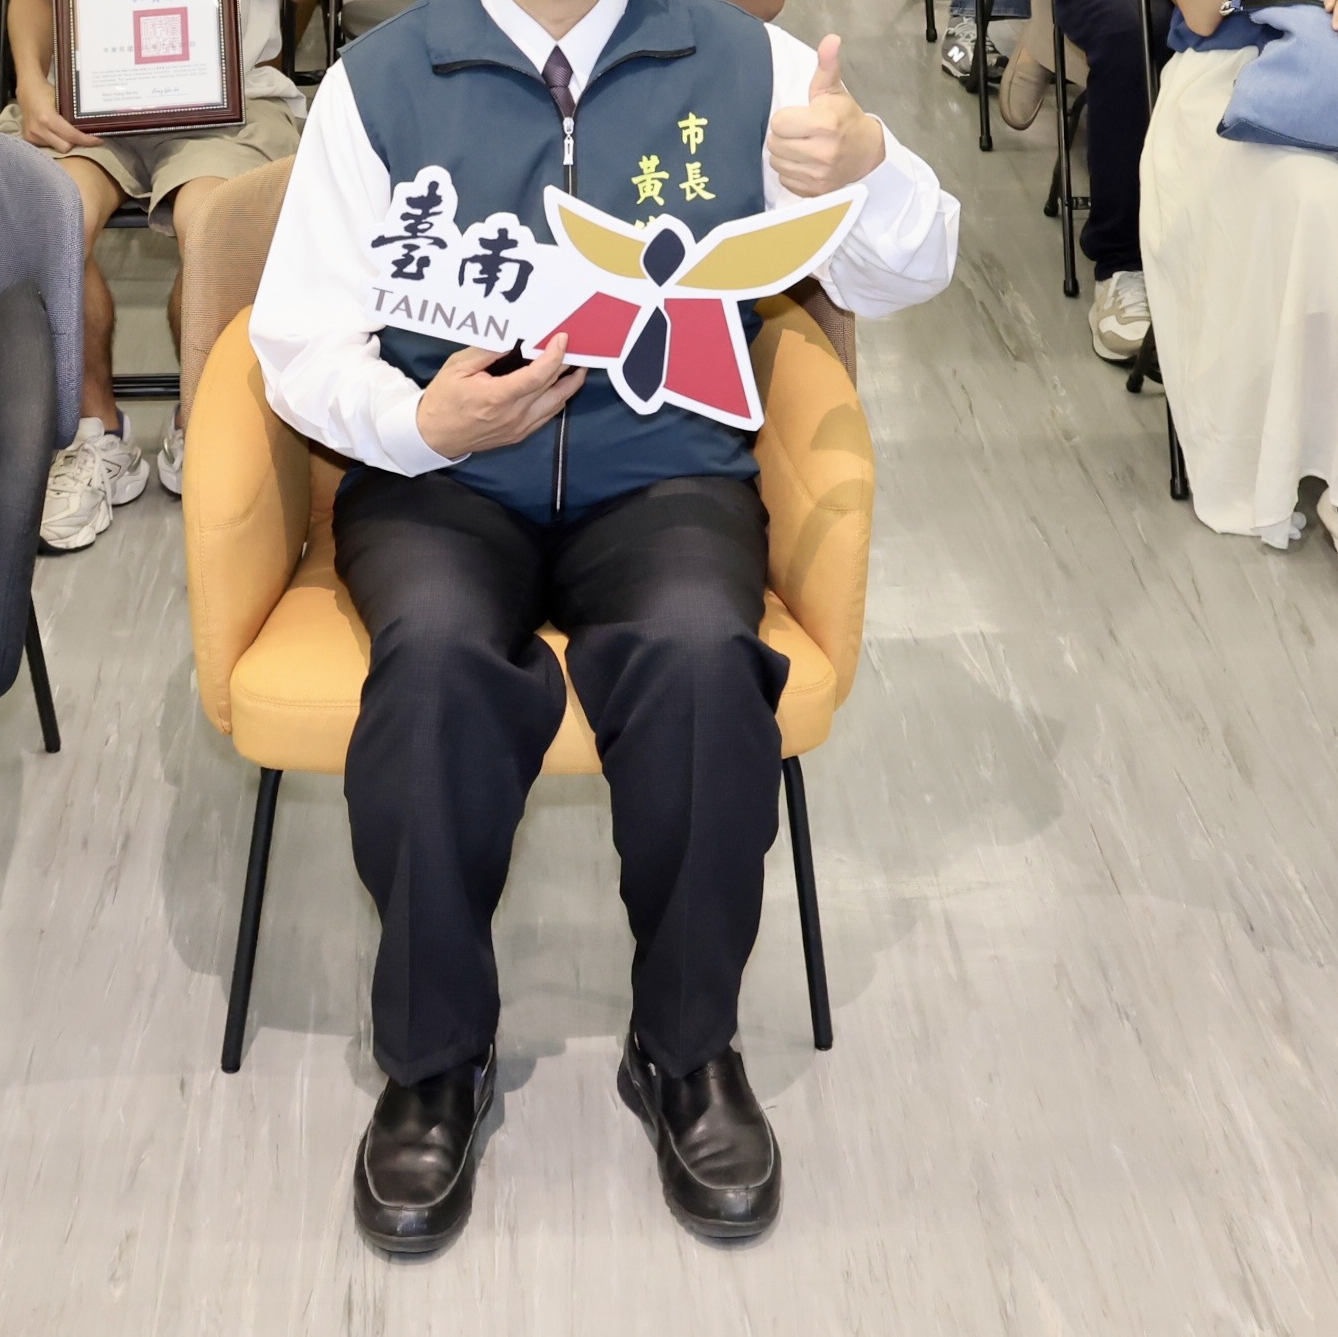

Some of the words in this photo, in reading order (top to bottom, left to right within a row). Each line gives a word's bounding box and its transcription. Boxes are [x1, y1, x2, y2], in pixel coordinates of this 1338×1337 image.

[947, 45, 965, 63] N
[631, 154, 670, 230] 黃
[677, 111, 716, 202] 市長
[371, 181, 534, 304] 臺南
[371, 287, 510, 342] TAINAN
